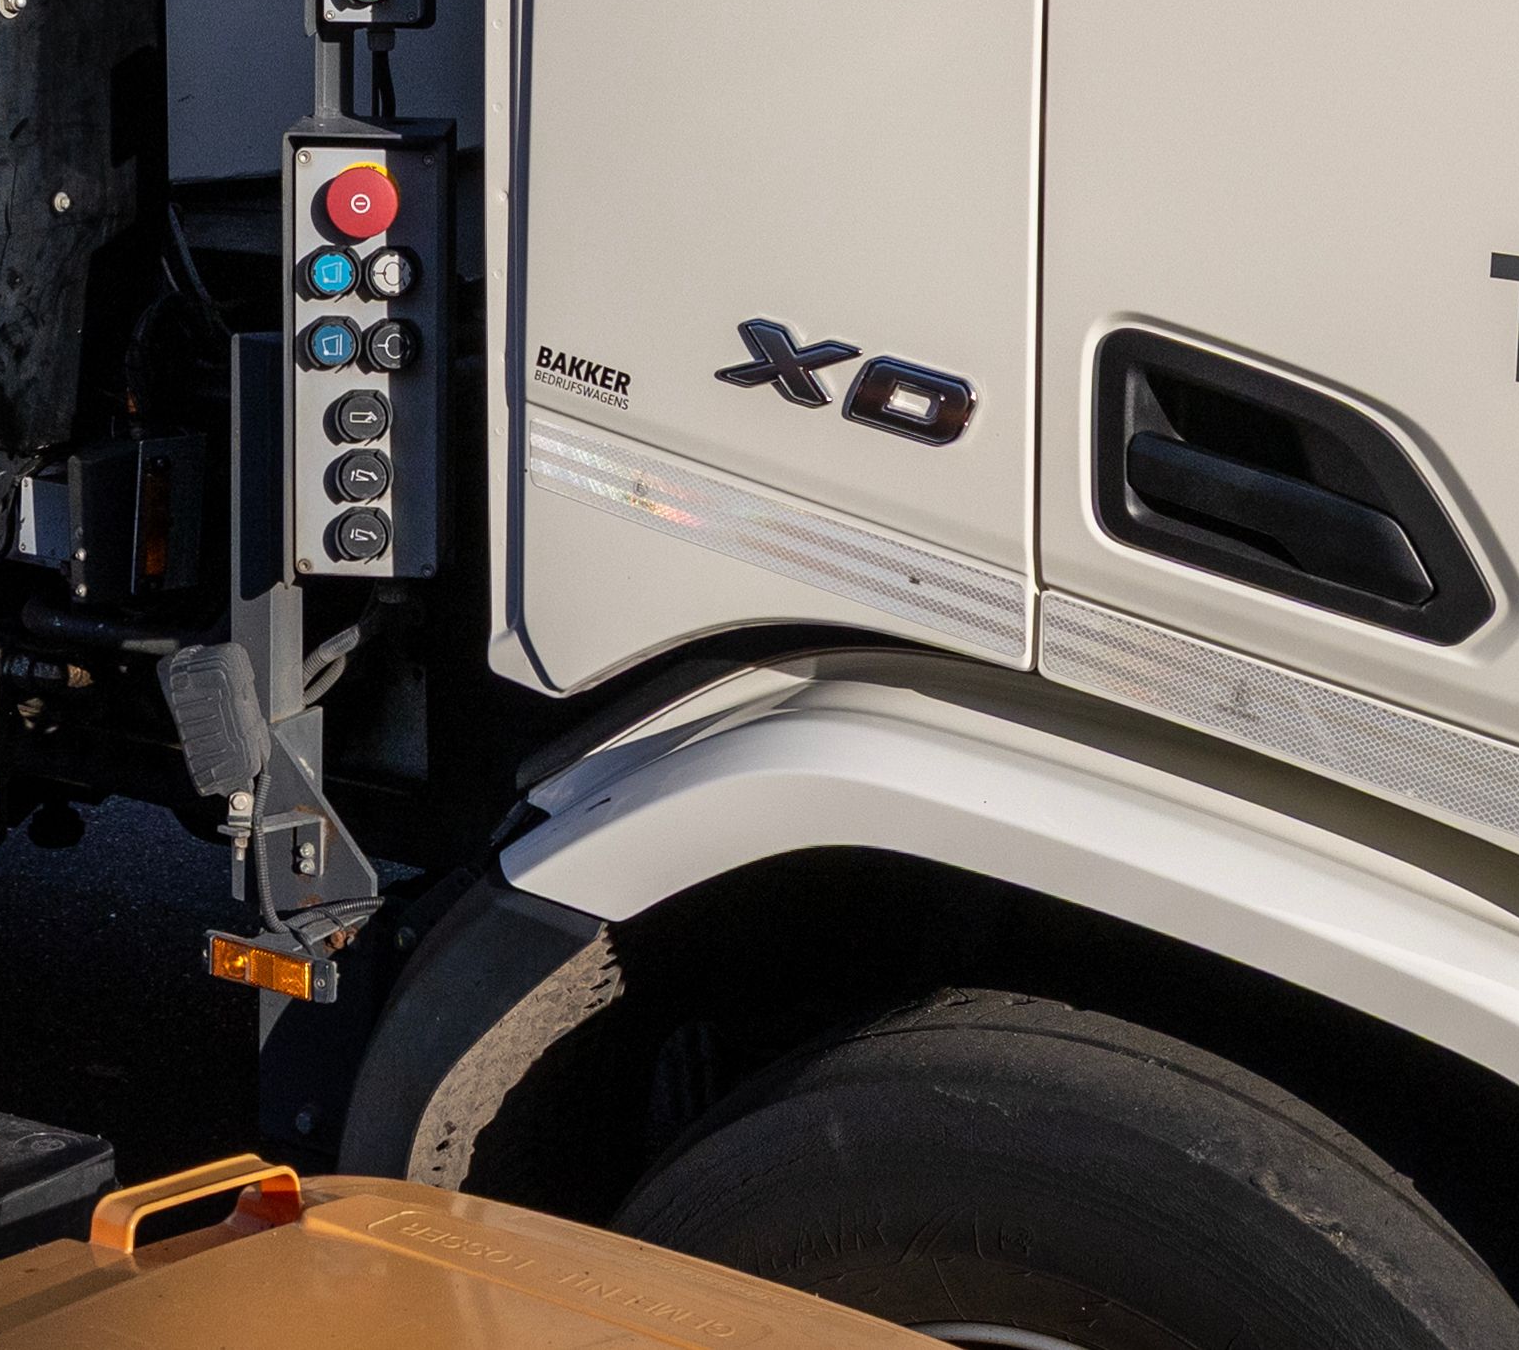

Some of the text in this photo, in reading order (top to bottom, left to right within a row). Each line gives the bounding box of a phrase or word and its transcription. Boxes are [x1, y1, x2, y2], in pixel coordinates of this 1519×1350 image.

[534, 369, 630, 410] BEDRIJFSWAGENS
[536, 345, 632, 396] BAKKER
[713, 317, 979, 448] XD
